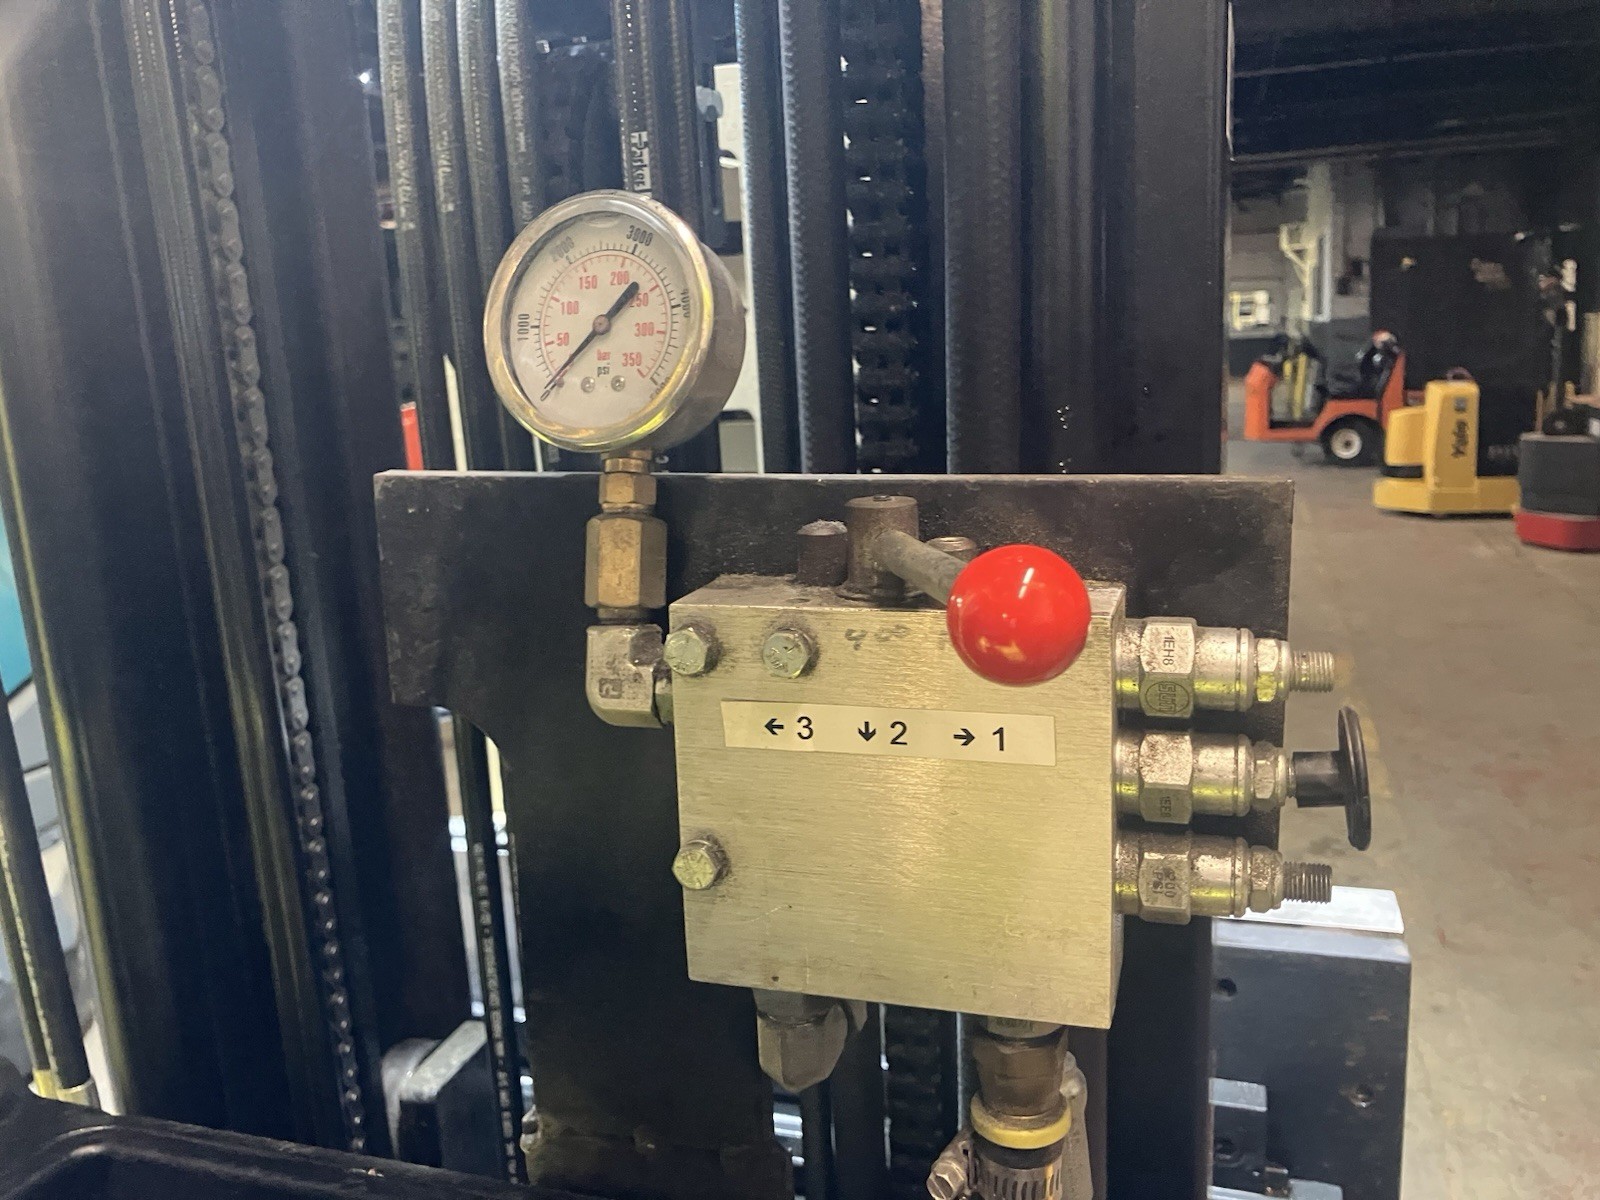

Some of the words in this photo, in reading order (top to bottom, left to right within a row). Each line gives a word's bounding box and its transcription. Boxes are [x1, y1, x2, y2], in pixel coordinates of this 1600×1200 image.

[630, 131, 651, 191] Parker
[626, 225, 653, 247] 3000
[579, 275, 598, 290] 150
[610, 271, 629, 286] 200
[560, 301, 579, 315] 100
[517, 313, 530, 342] 1000
[634, 322, 655, 337] 300
[556, 332, 570, 347] 50
[597, 349, 611, 361] bar
[622, 352, 642, 367] 350
[597, 362, 610, 378] psi
[1162, 635, 1175, 666] 1EH8
[796, 716, 815, 740] 3
[889, 721, 908, 745] 2
[992, 727, 1005, 751] 1
